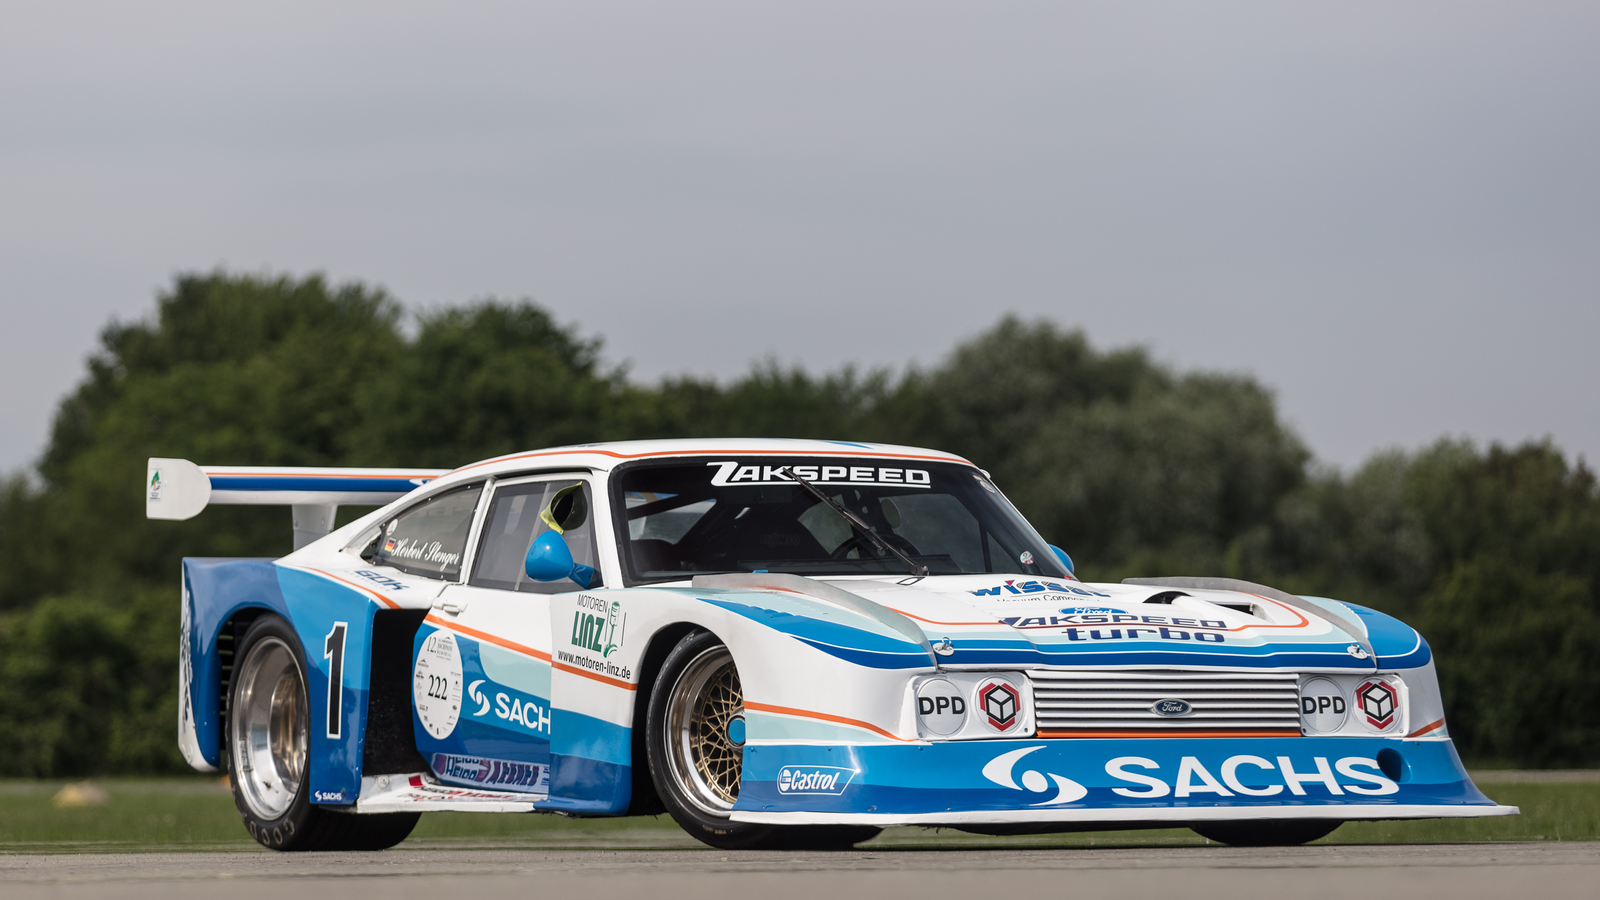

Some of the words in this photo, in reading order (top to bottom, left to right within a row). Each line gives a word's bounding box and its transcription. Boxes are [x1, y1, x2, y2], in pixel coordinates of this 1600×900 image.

[706, 461, 931, 488] ZAKSPEED
[391, 538, 428, 560] Herbert
[424, 541, 460, 572] Stenger
[577, 594, 609, 613] MOTOREN
[571, 611, 606, 652] LINZ
[1061, 627, 1225, 643] turbo
[558, 650, 631, 679] www.motoren-linz.de
[324, 621, 348, 739] 1
[427, 674, 448, 701] 222
[918, 696, 966, 715] DPD
[1162, 701, 1183, 712] Ford
[1301, 696, 1346, 714] DPD
[791, 769, 841, 790] Castrol
[1105, 755, 1400, 798] SACHS
[322, 791, 343, 801] SACHS
